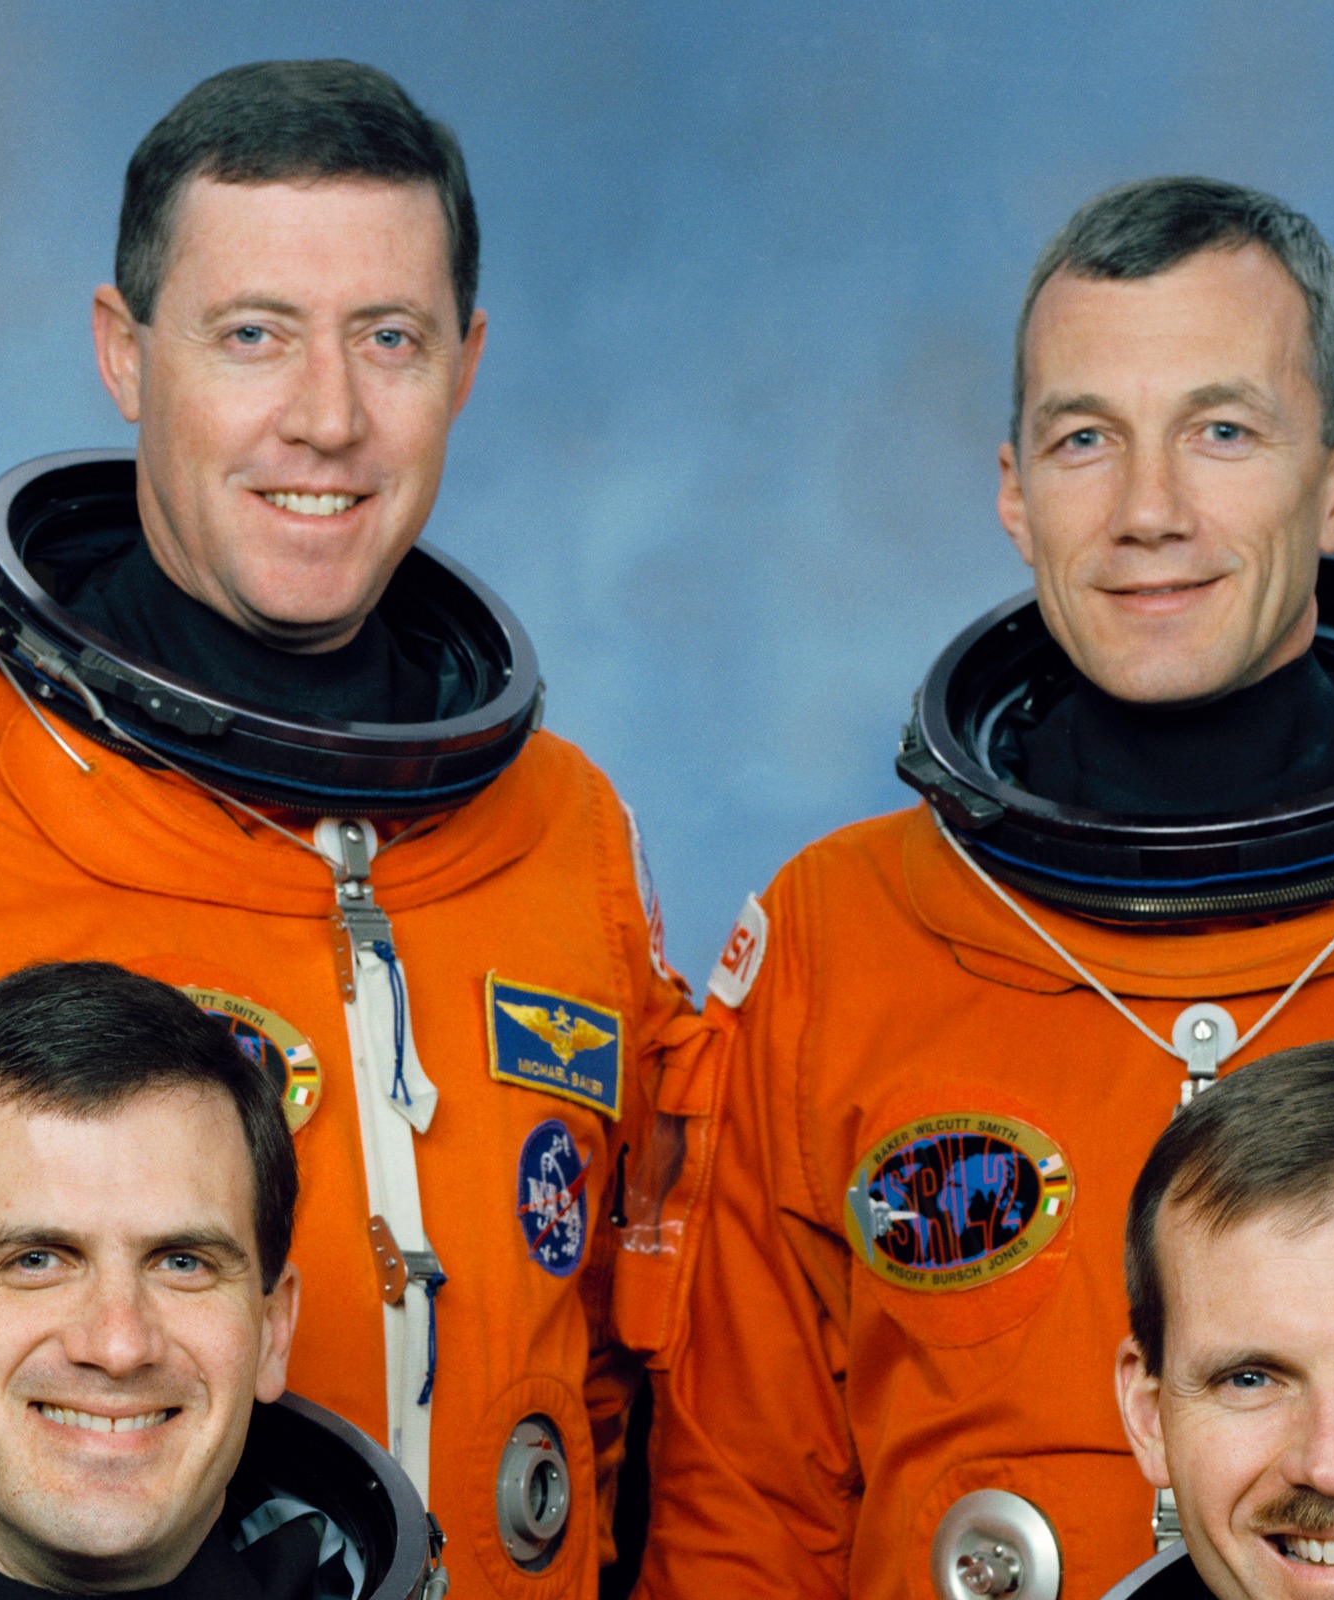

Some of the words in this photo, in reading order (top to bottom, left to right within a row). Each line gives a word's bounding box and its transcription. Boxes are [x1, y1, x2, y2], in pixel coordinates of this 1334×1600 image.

[224, 1000, 265, 1027] SMITH
[518, 1057, 568, 1084] MICHAEL
[874, 1132, 910, 1164] BAKER
[914, 1118, 970, 1135] WILCUTT
[977, 1120, 1018, 1142] SMITH
[886, 1261, 926, 1284] WISOFF
[932, 1266, 982, 1285] BURSCH
[988, 1237, 1029, 1271] JONES
